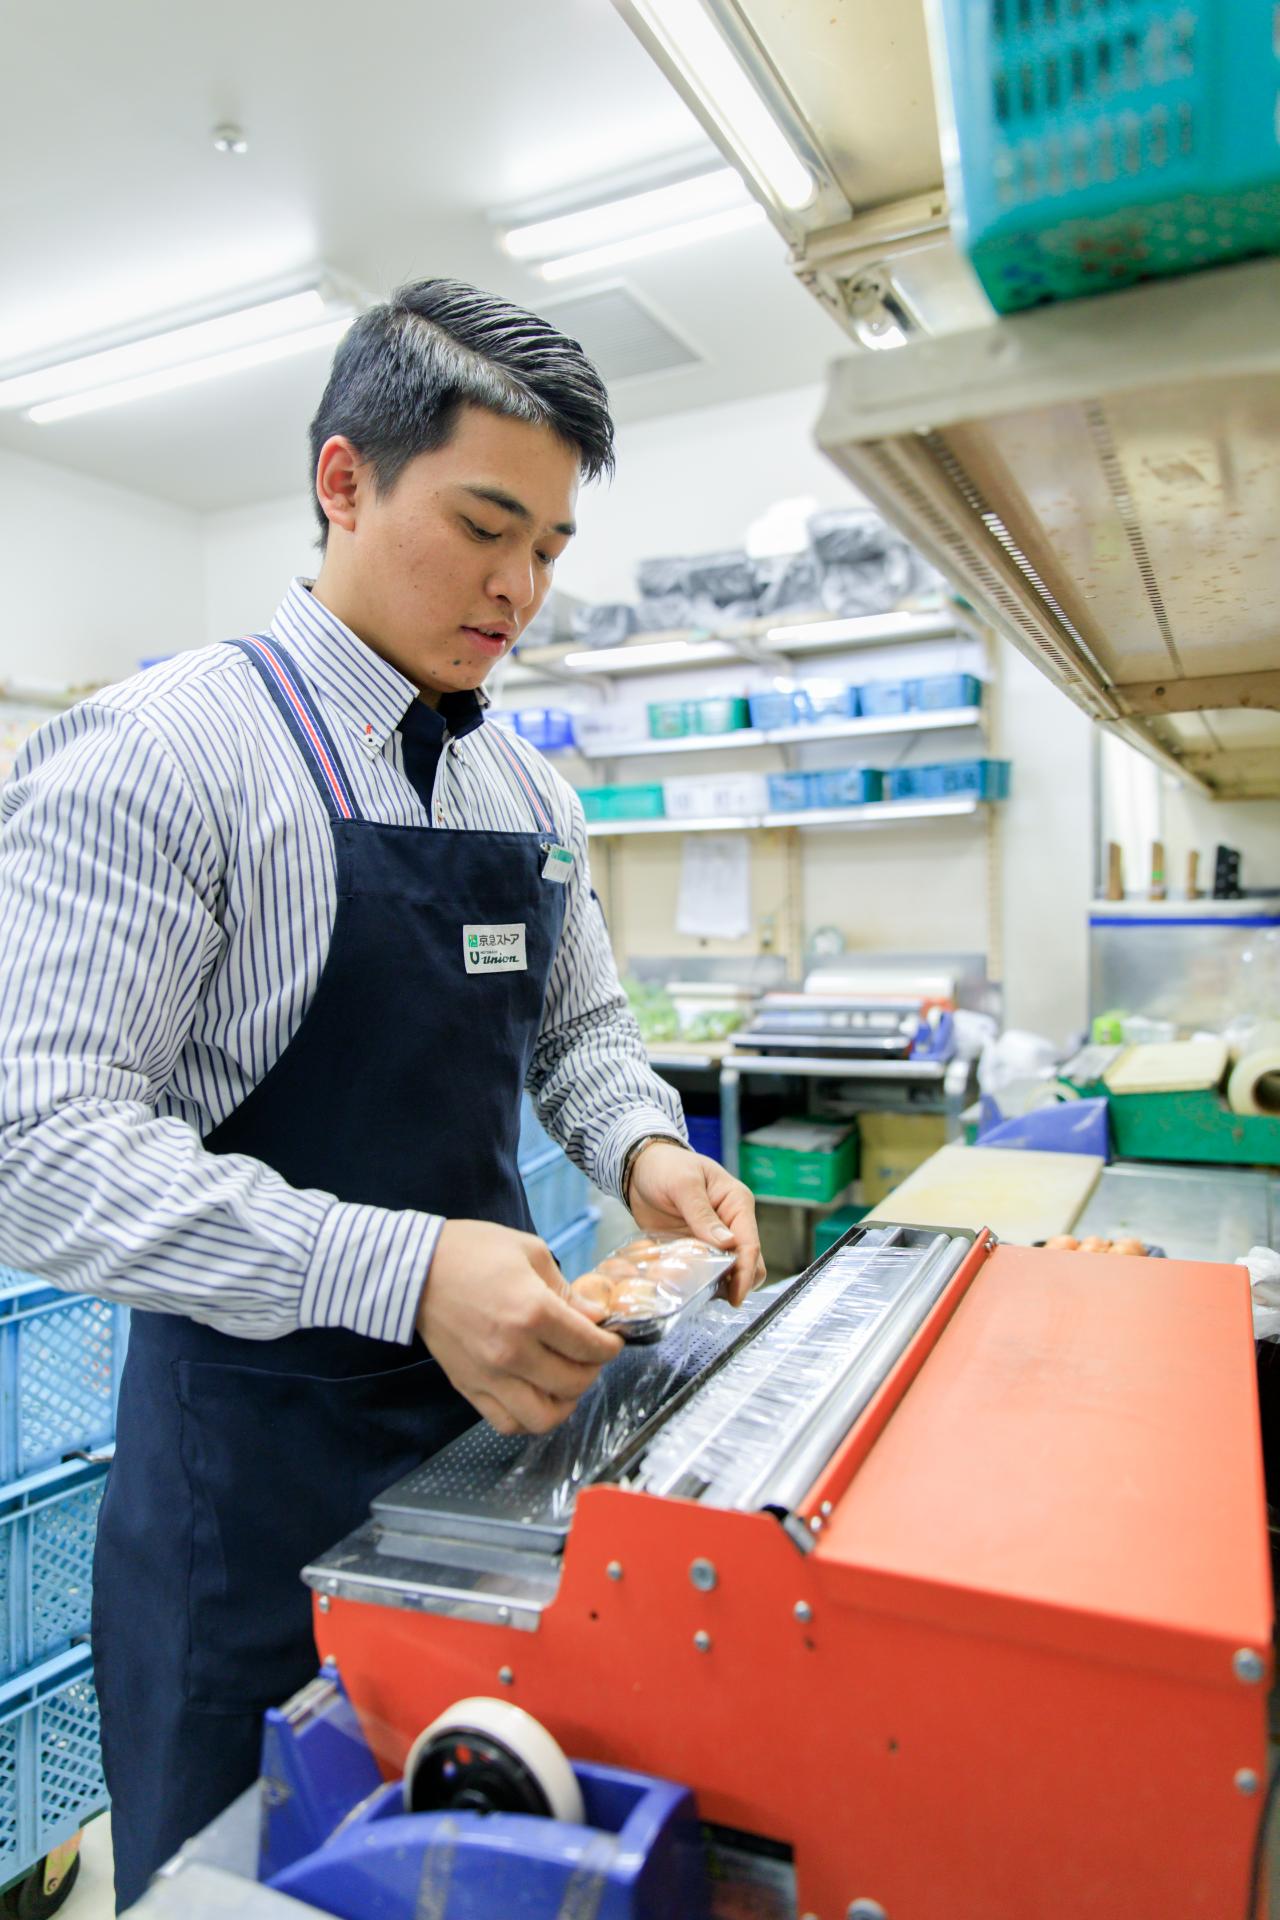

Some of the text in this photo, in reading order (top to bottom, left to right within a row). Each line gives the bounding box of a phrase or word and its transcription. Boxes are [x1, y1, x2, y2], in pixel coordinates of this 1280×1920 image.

[479, 933, 520, 947] 京急ストア
